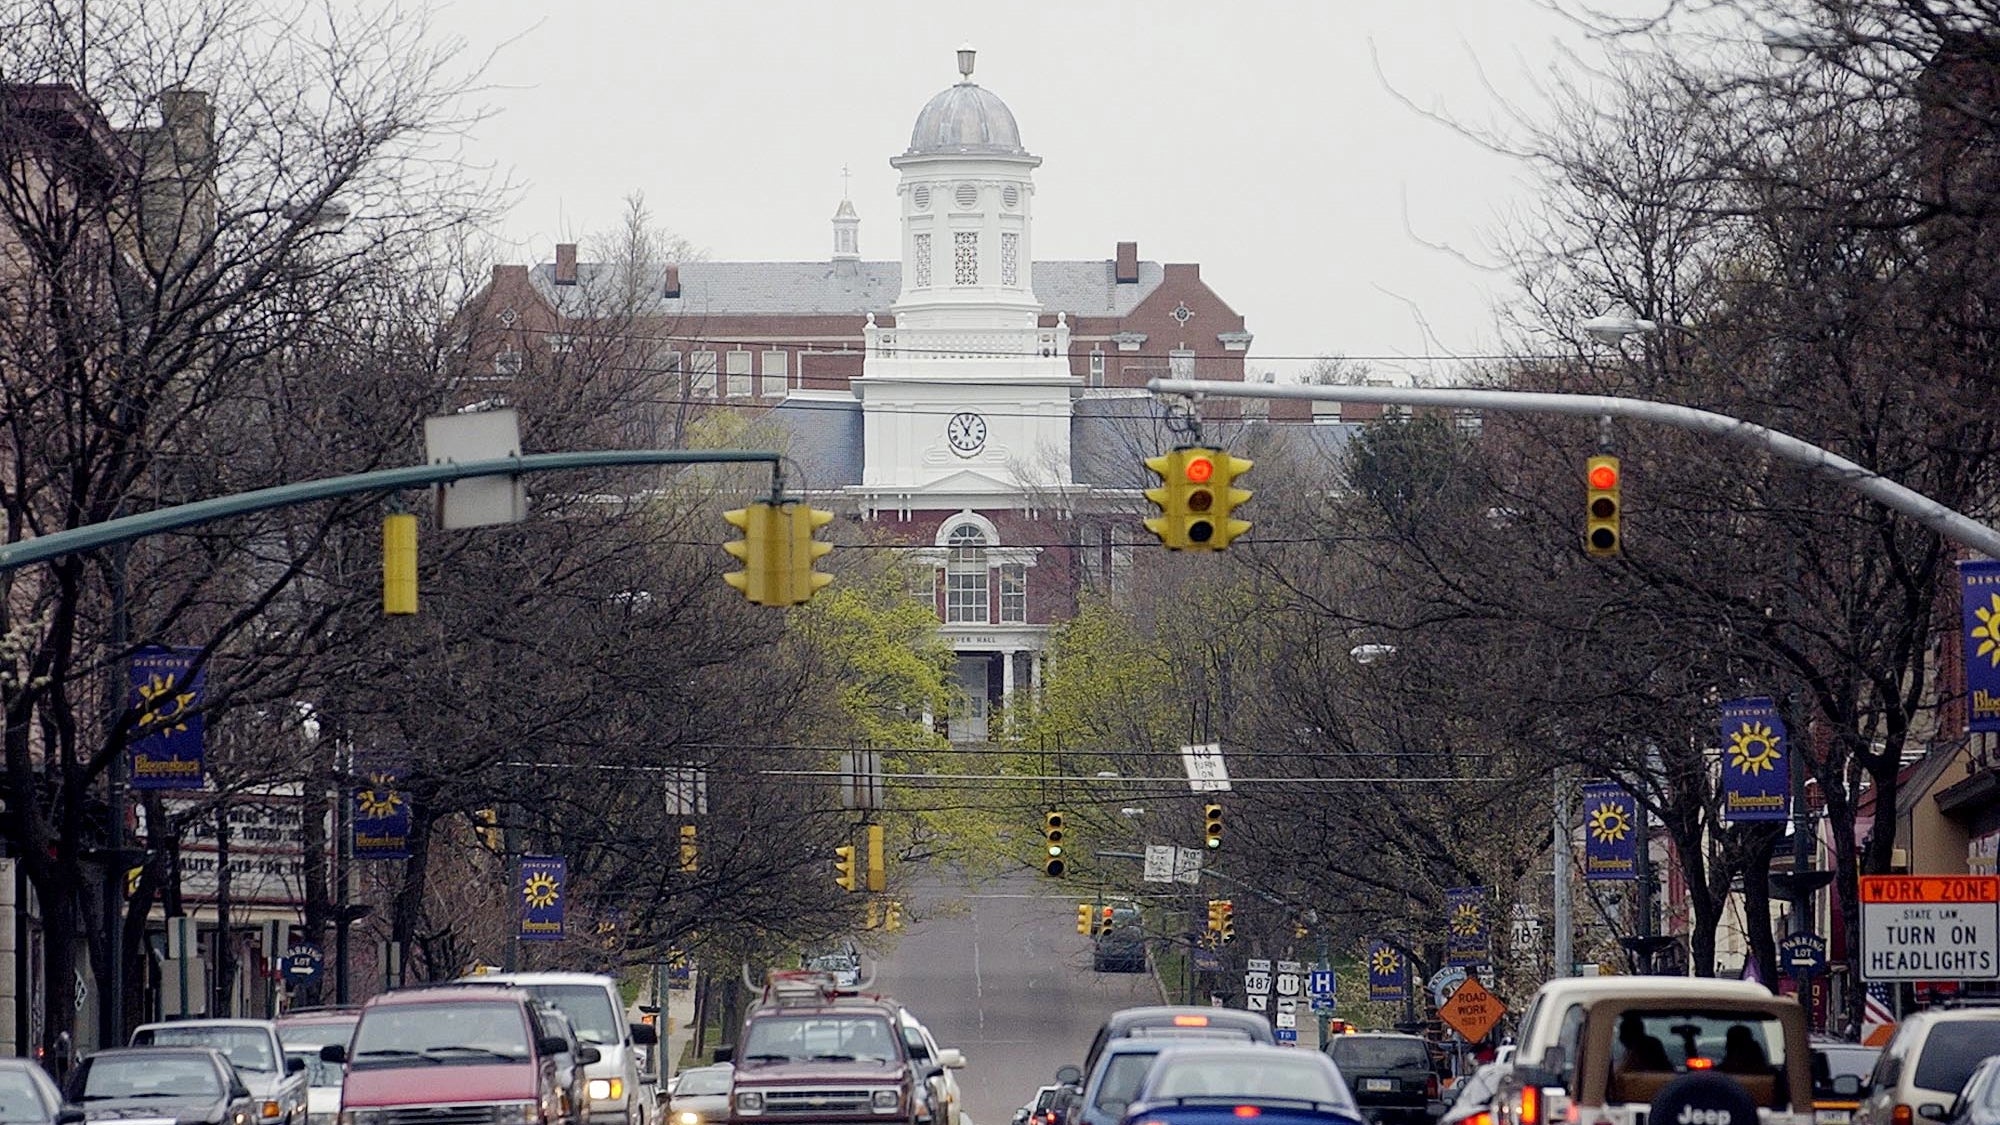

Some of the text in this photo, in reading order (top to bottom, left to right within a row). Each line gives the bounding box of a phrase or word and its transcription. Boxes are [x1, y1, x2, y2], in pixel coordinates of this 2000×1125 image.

[134, 659, 190, 668] DISCOVE
[1725, 708, 1773, 717] DISCOVE
[1869, 881, 1990, 900] WORK ZONE
[1903, 909, 1958, 920] STATE LAW
[1886, 925, 1977, 945] TURN ON
[1782, 937, 1824, 951] PARKING
[1795, 948, 1812, 957] LOT
[294, 957, 311, 966] LOT
[1872, 951, 1990, 970] HEADLIGHTS
[1248, 977, 1271, 989] 487
[1283, 979, 1293, 991] 11
[1316, 973, 1331, 992] H
[1459, 992, 1487, 1003] ROAD
[1458, 1005, 1487, 1014] WORK
[1280, 1031, 1292, 1039] TO
[1677, 1103, 1732, 1125] Jeep
